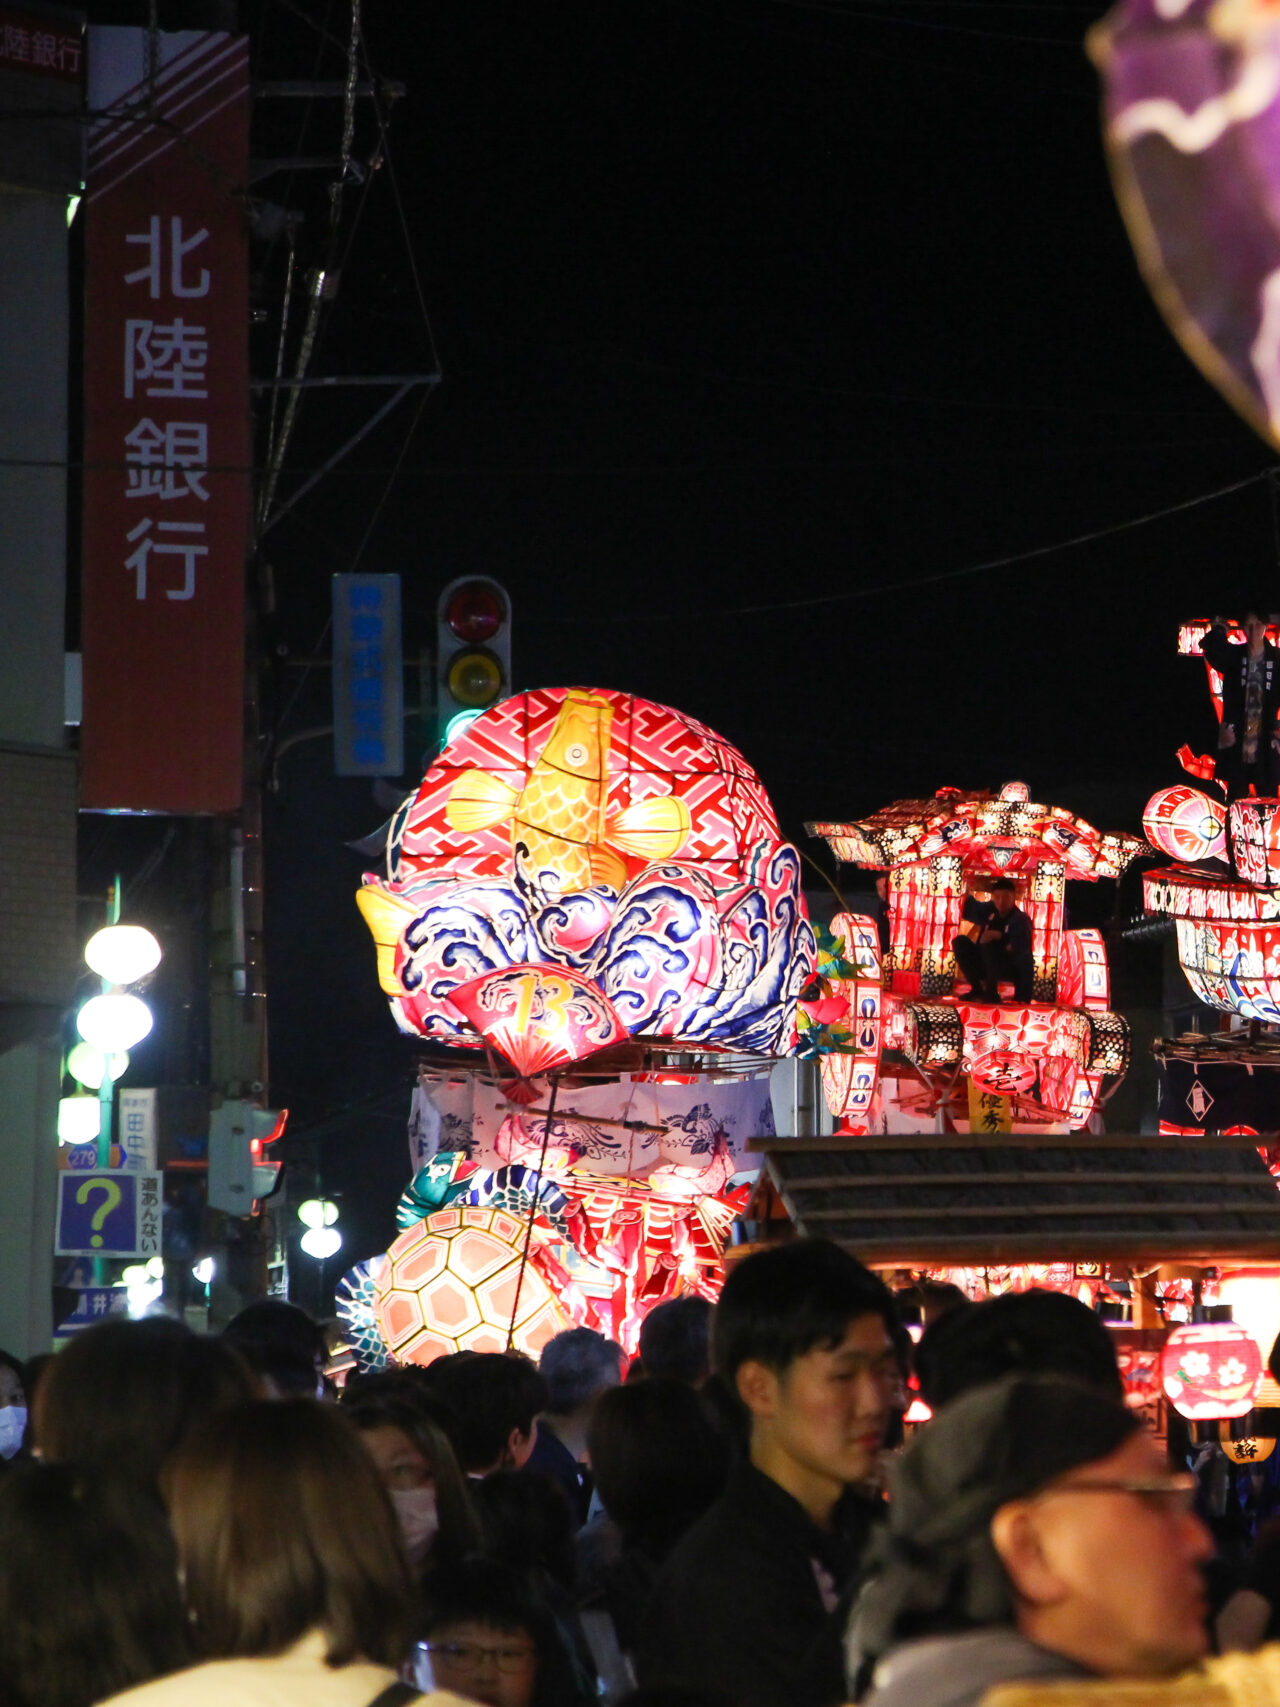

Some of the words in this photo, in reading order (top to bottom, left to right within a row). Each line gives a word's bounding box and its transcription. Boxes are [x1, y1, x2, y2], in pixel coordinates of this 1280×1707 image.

[0, 24, 81, 73] 陸銀行
[124, 215, 211, 600] 北陸銀行
[516, 976, 573, 1037] 13
[70, 1150, 96, 1168] 279
